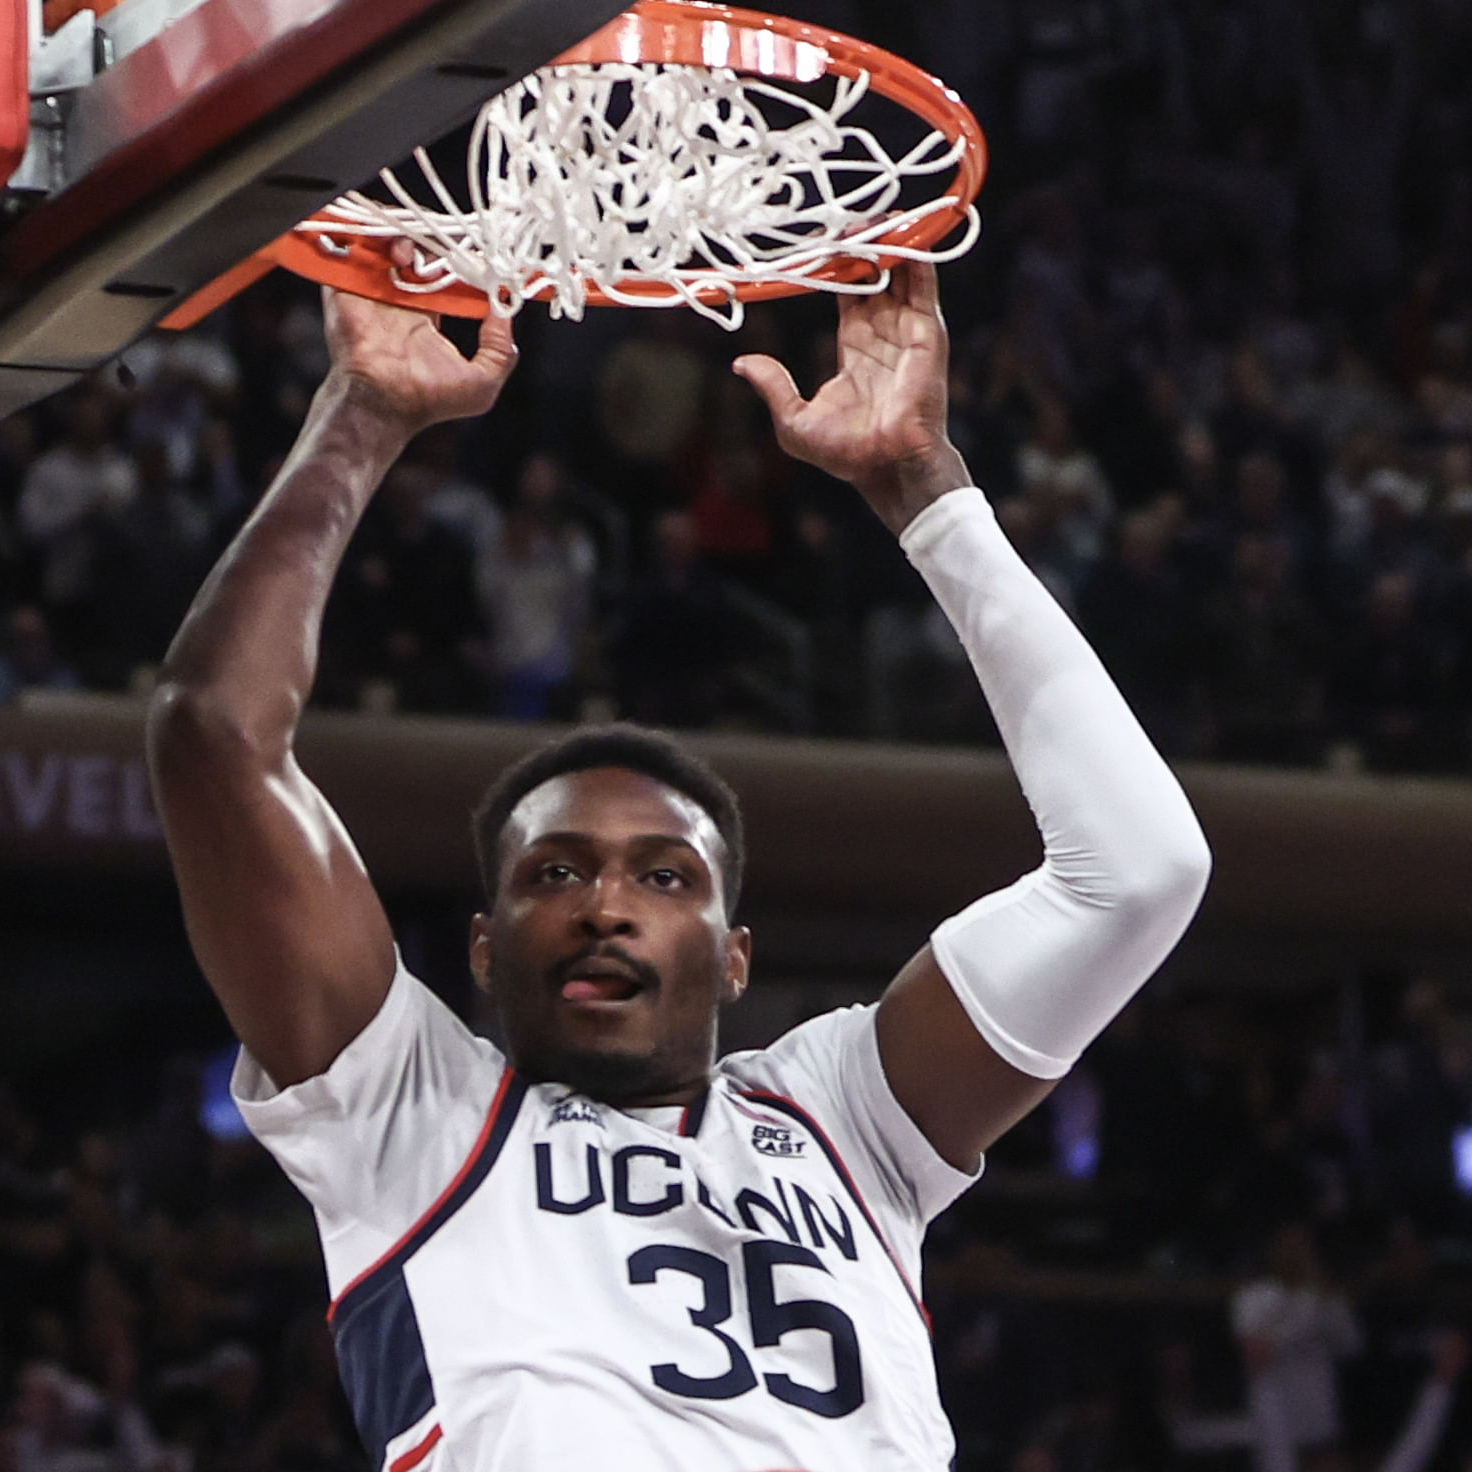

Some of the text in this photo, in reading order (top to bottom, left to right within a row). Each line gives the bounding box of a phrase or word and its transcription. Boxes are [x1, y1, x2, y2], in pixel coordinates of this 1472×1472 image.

[753, 1125, 791, 1141] BIG
[751, 1137, 807, 1158] EAST
[626, 1239, 865, 1419] 35
